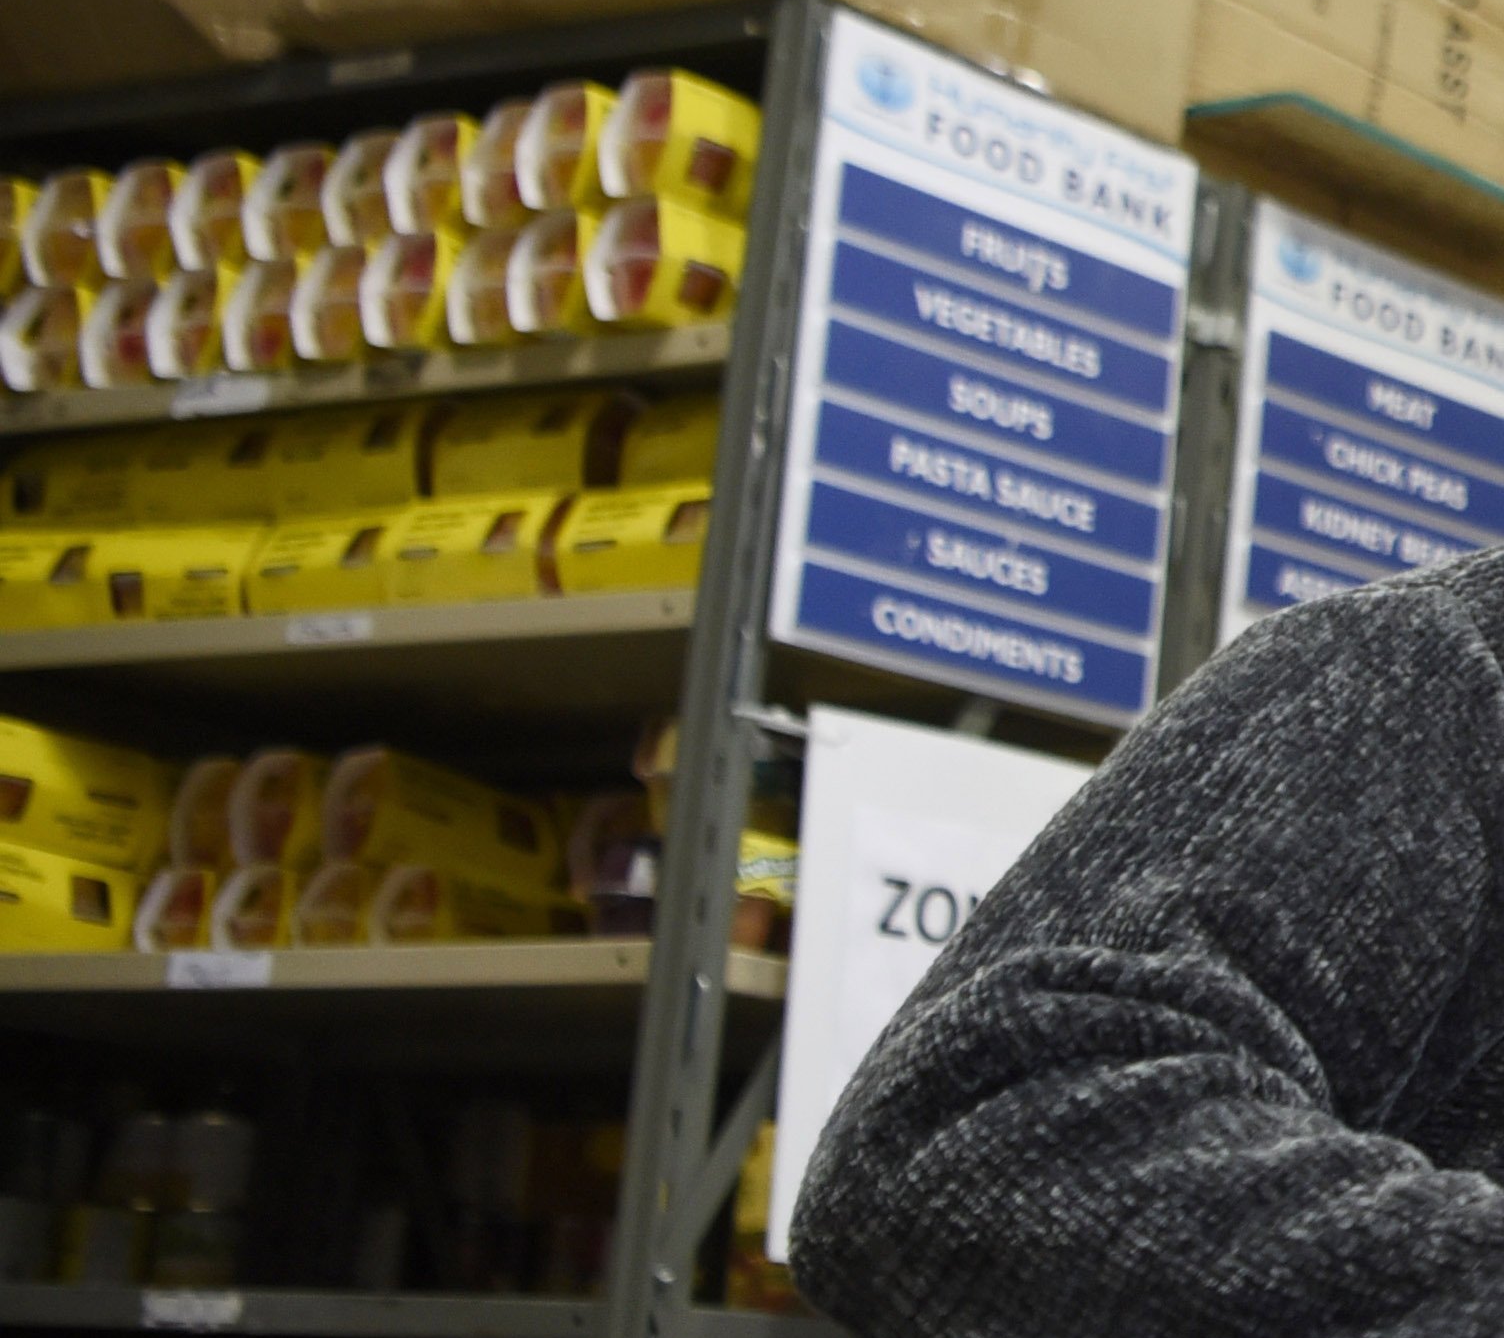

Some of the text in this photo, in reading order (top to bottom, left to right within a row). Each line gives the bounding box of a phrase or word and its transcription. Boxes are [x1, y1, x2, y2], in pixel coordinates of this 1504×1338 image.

[924, 109, 1174, 235] FOOD BANK
[912, 281, 1101, 380] VEGETABLES
[1329, 281, 1426, 344] FOOD
[948, 374, 1054, 441] SOUPS
[888, 435, 1097, 534] PASTA SAUCE
[925, 527, 1050, 597] SAUCES
[870, 594, 1085, 685] CONDIMENTS
[879, 874, 979, 945] ZO
